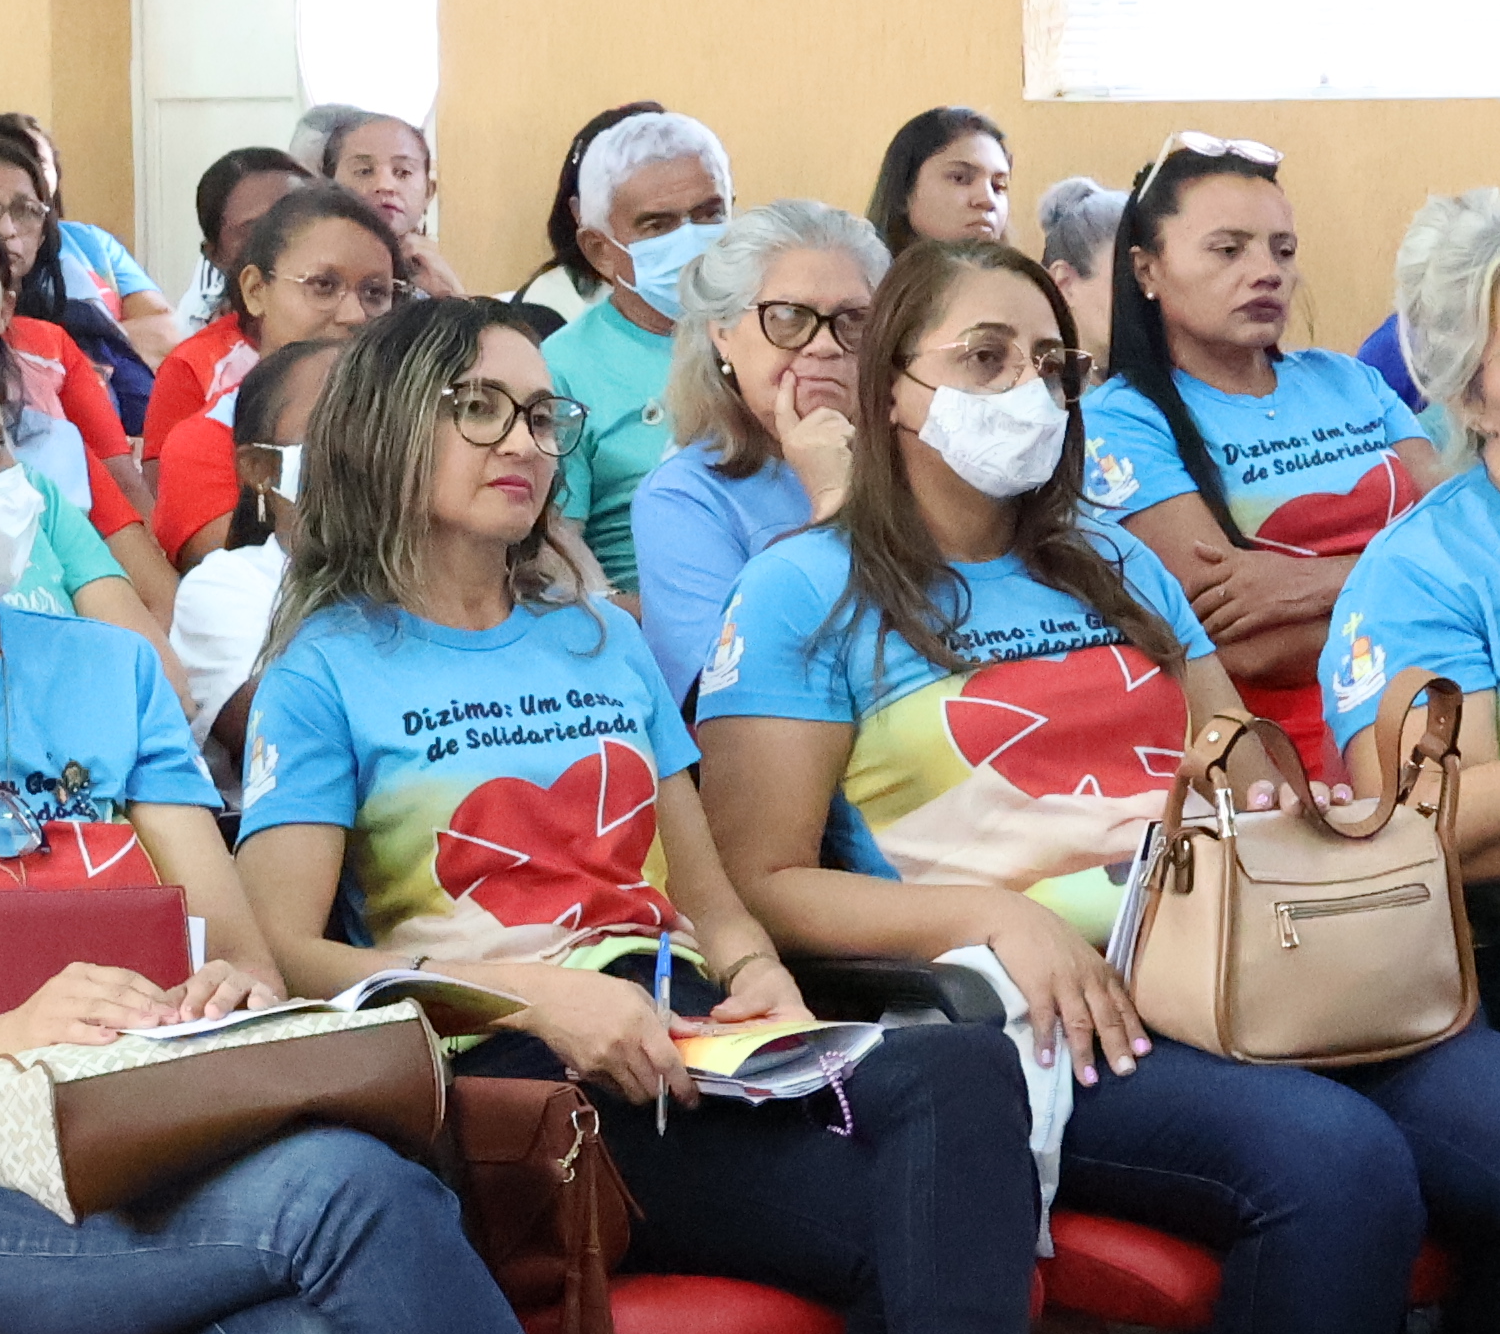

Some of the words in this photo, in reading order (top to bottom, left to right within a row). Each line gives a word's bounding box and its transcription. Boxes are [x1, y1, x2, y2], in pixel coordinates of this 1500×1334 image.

[1312, 427, 1344, 442] Um
[1242, 463, 1269, 485] de
[1039, 618, 1081, 635] Um
[519, 694, 562, 717] Um
[427, 736, 460, 763] de
[465, 712, 639, 750] Solidariedade
